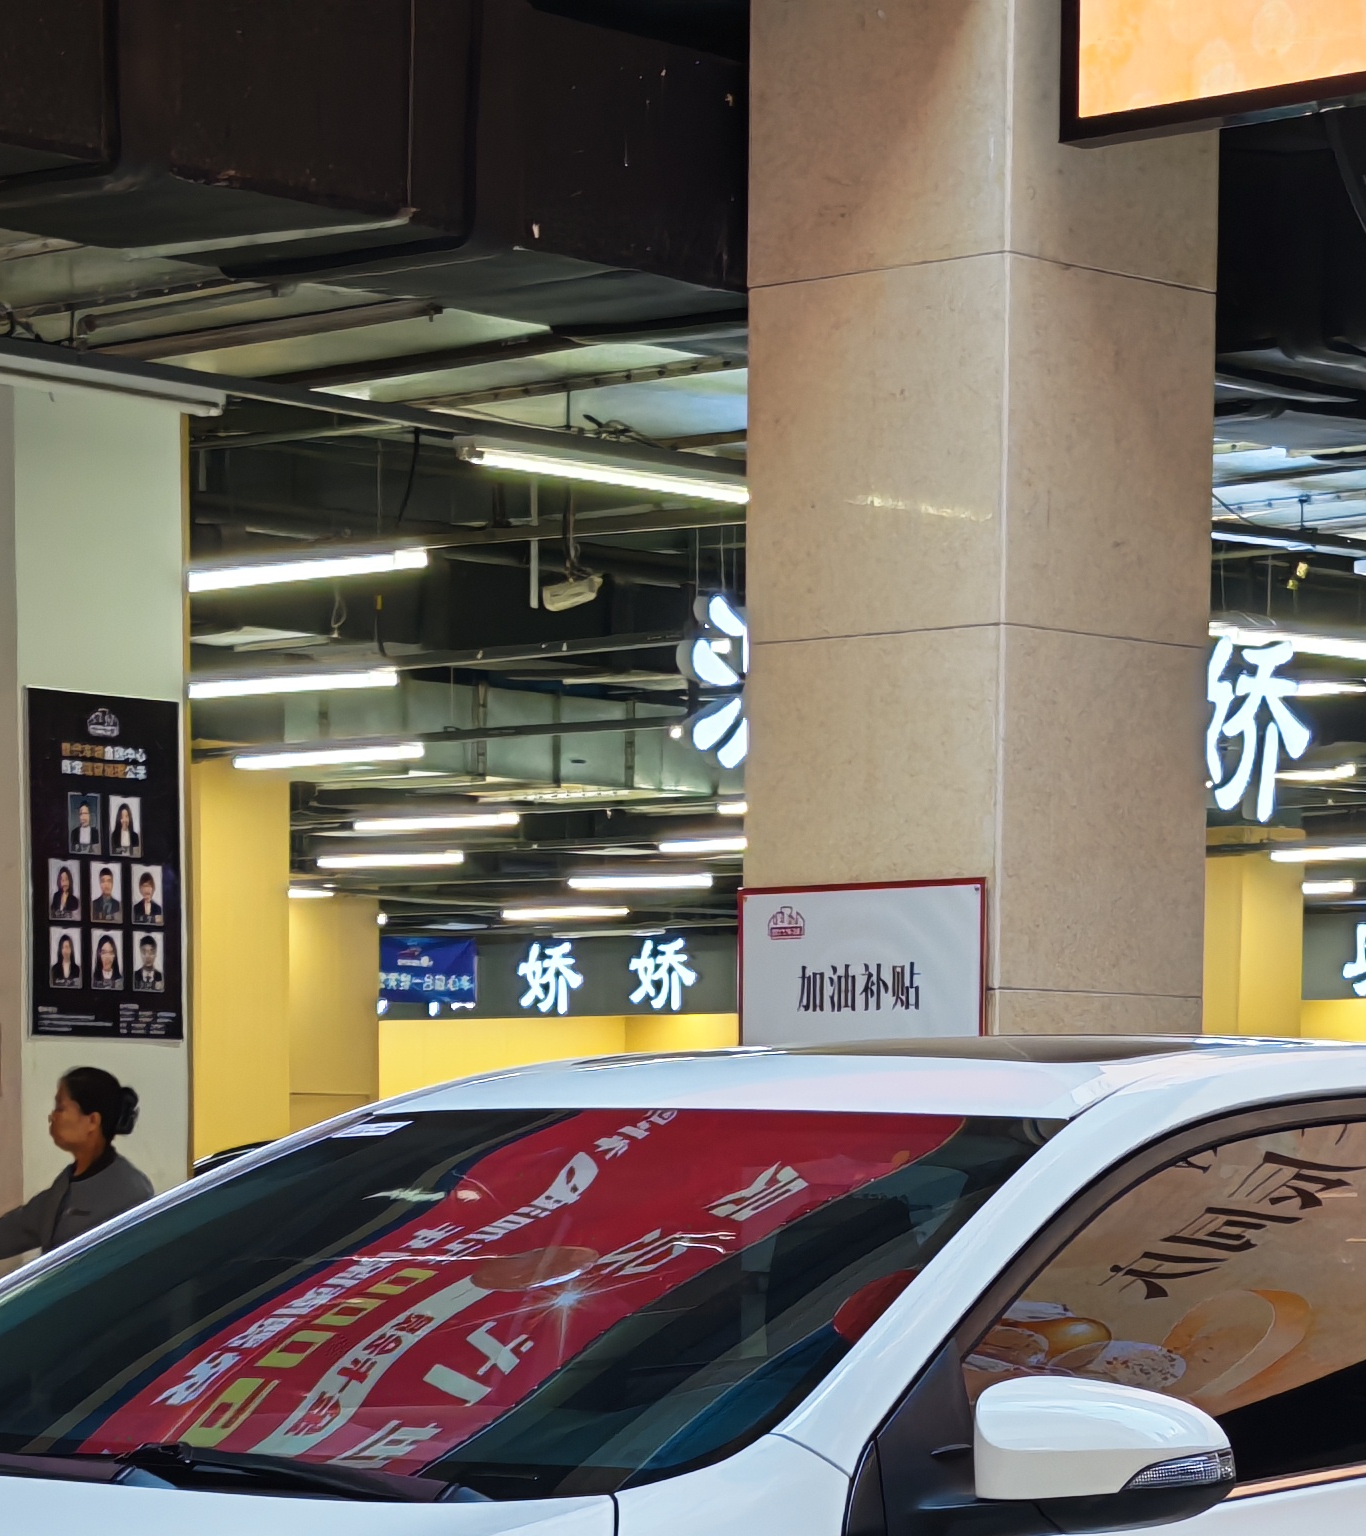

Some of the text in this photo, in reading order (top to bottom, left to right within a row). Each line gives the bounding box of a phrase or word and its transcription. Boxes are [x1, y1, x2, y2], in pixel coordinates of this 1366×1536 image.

[517, 938, 695, 1015] 娇娇
[797, 961, 921, 1012] 加油补贴
